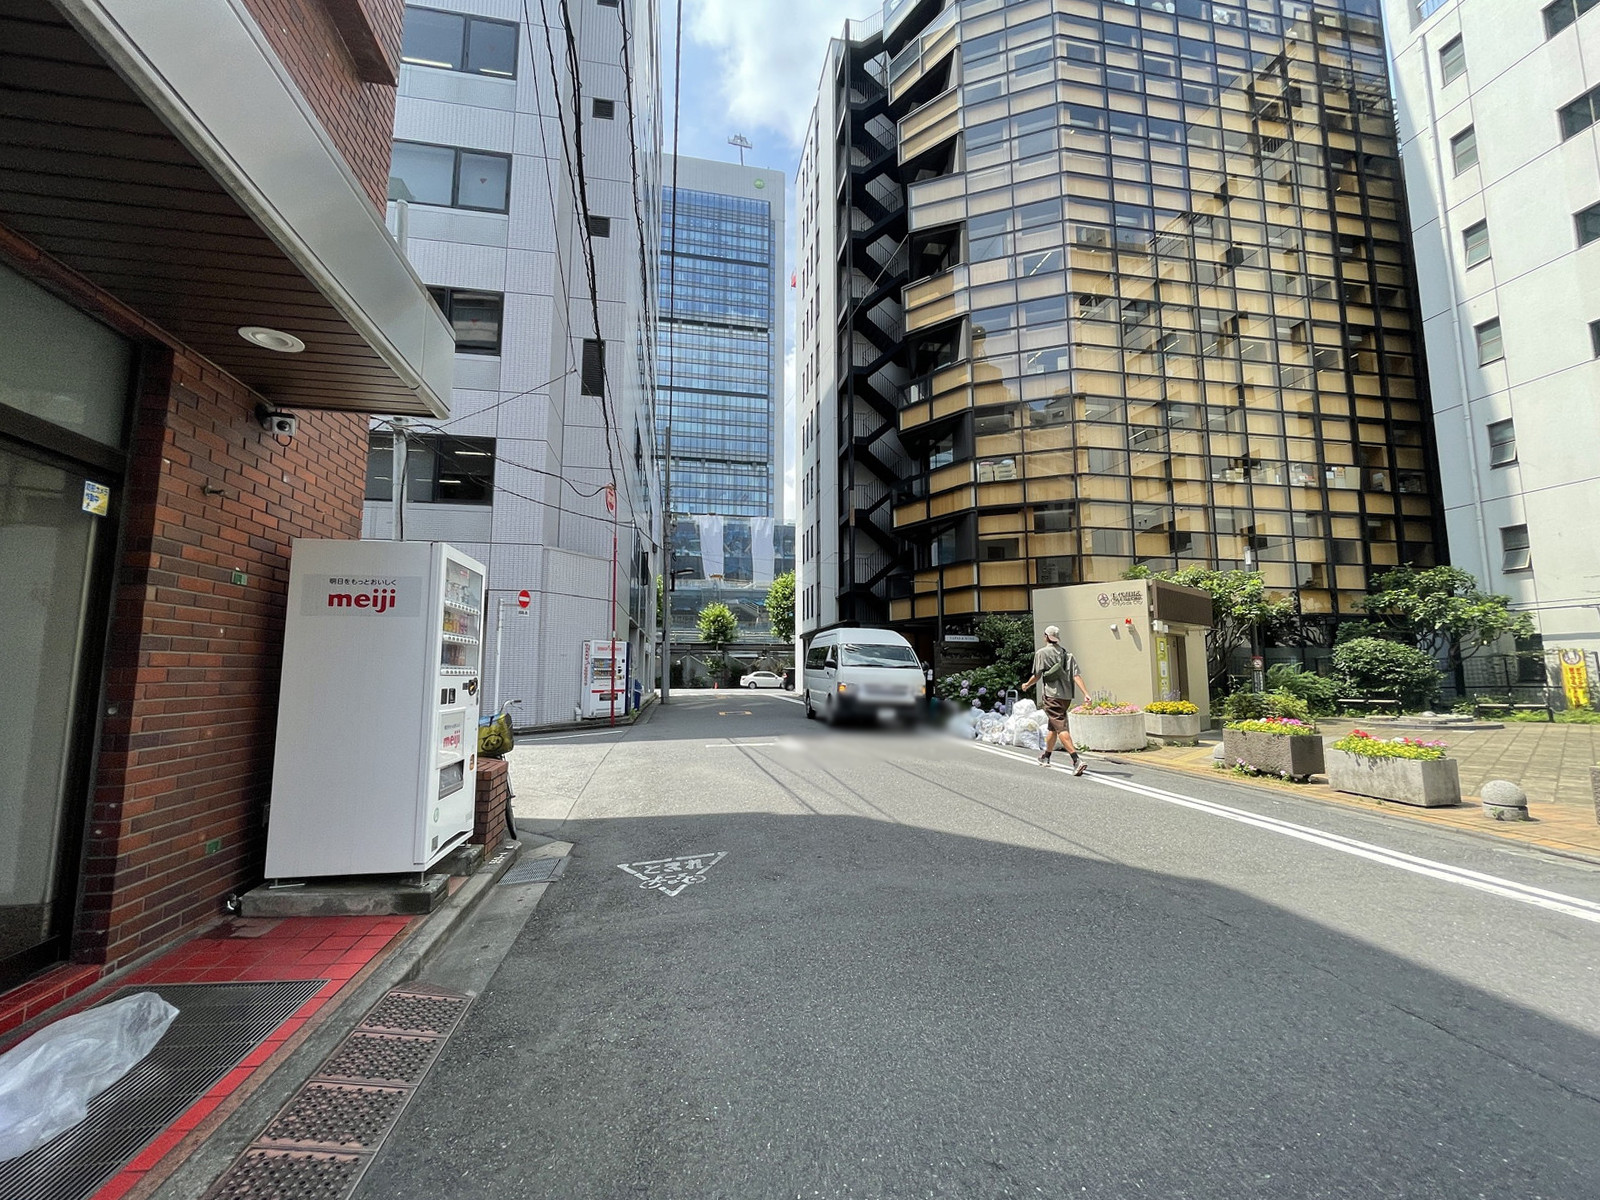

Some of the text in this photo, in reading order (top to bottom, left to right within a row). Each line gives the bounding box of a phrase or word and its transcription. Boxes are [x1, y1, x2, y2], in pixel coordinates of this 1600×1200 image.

[329, 577, 397, 586] 明日をもっとおいしく
[328, 588, 396, 613] meiji
[443, 730, 461, 748] meiji
[644, 859, 704, 874] とまれ
